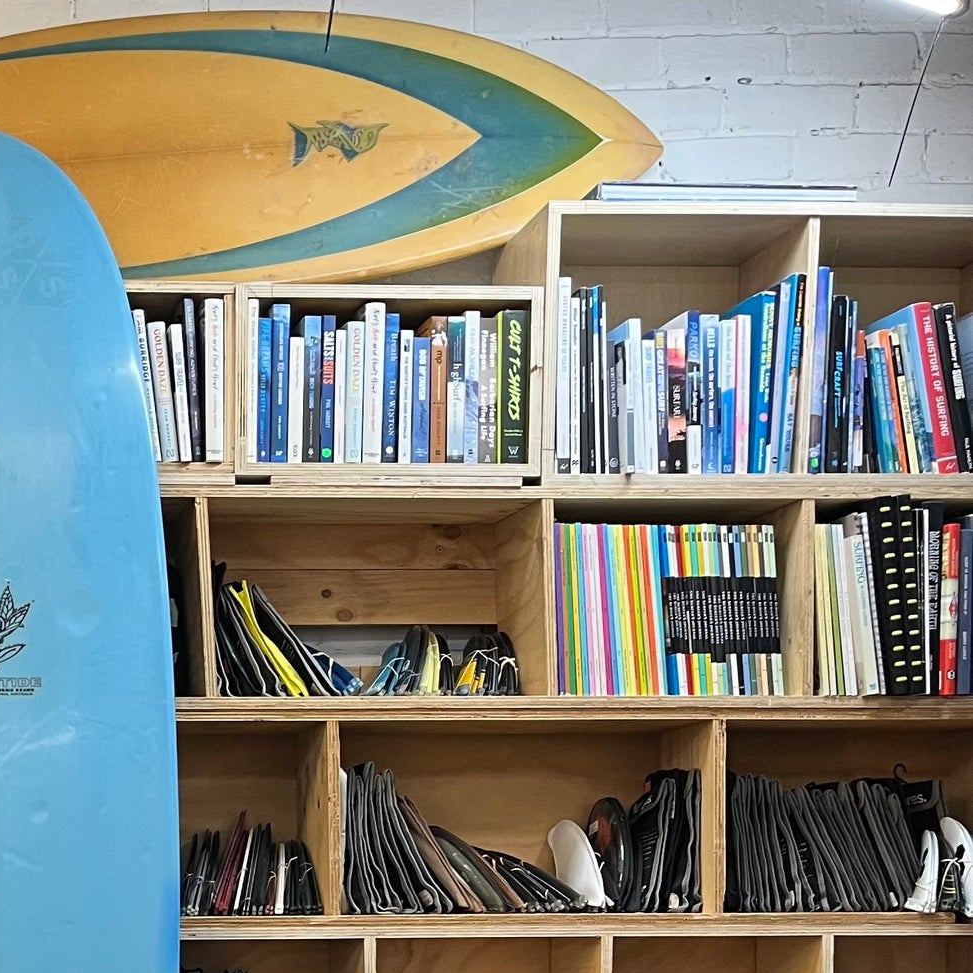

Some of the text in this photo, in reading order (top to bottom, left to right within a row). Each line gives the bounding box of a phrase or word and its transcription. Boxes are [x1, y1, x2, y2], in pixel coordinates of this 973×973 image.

[508, 320, 521, 352] CULT
[689, 322, 699, 358] PARKO
[790, 327, 801, 367] SURFING
[945, 321, 955, 341] pictorial
[154, 329, 167, 394] GOLDEN DAZE
[323, 331, 334, 384] SALTS SUITS
[353, 328, 361, 367] GOLDEN
[390, 334, 398, 362] Breath
[434, 350, 442, 364] mp
[480, 330, 488, 370] Finnegan
[488, 333, 497, 368] William
[656, 350, 665, 374] GREAT
[949, 343, 957, 361] history
[175, 368, 183, 387] TRAVEL
[508, 358, 521, 420] T-SHIRTS
[922, 315, 949, 437] THE HISTORY OF SURFING
[951, 369, 965, 400] SURFING
[388, 400, 396, 436] WINTON
[479, 393, 488, 423] Surfing
[488, 378, 496, 448] Barbarian Days
[657, 392, 666, 412] SURF
[480, 425, 488, 440] Life
[853, 542, 866, 584] SURFING
[929, 531, 940, 570] MORNING
[929, 572, 939, 582] OF
[929, 602, 938, 630] EARTH
[0, 677, 42, 687] TIDE
